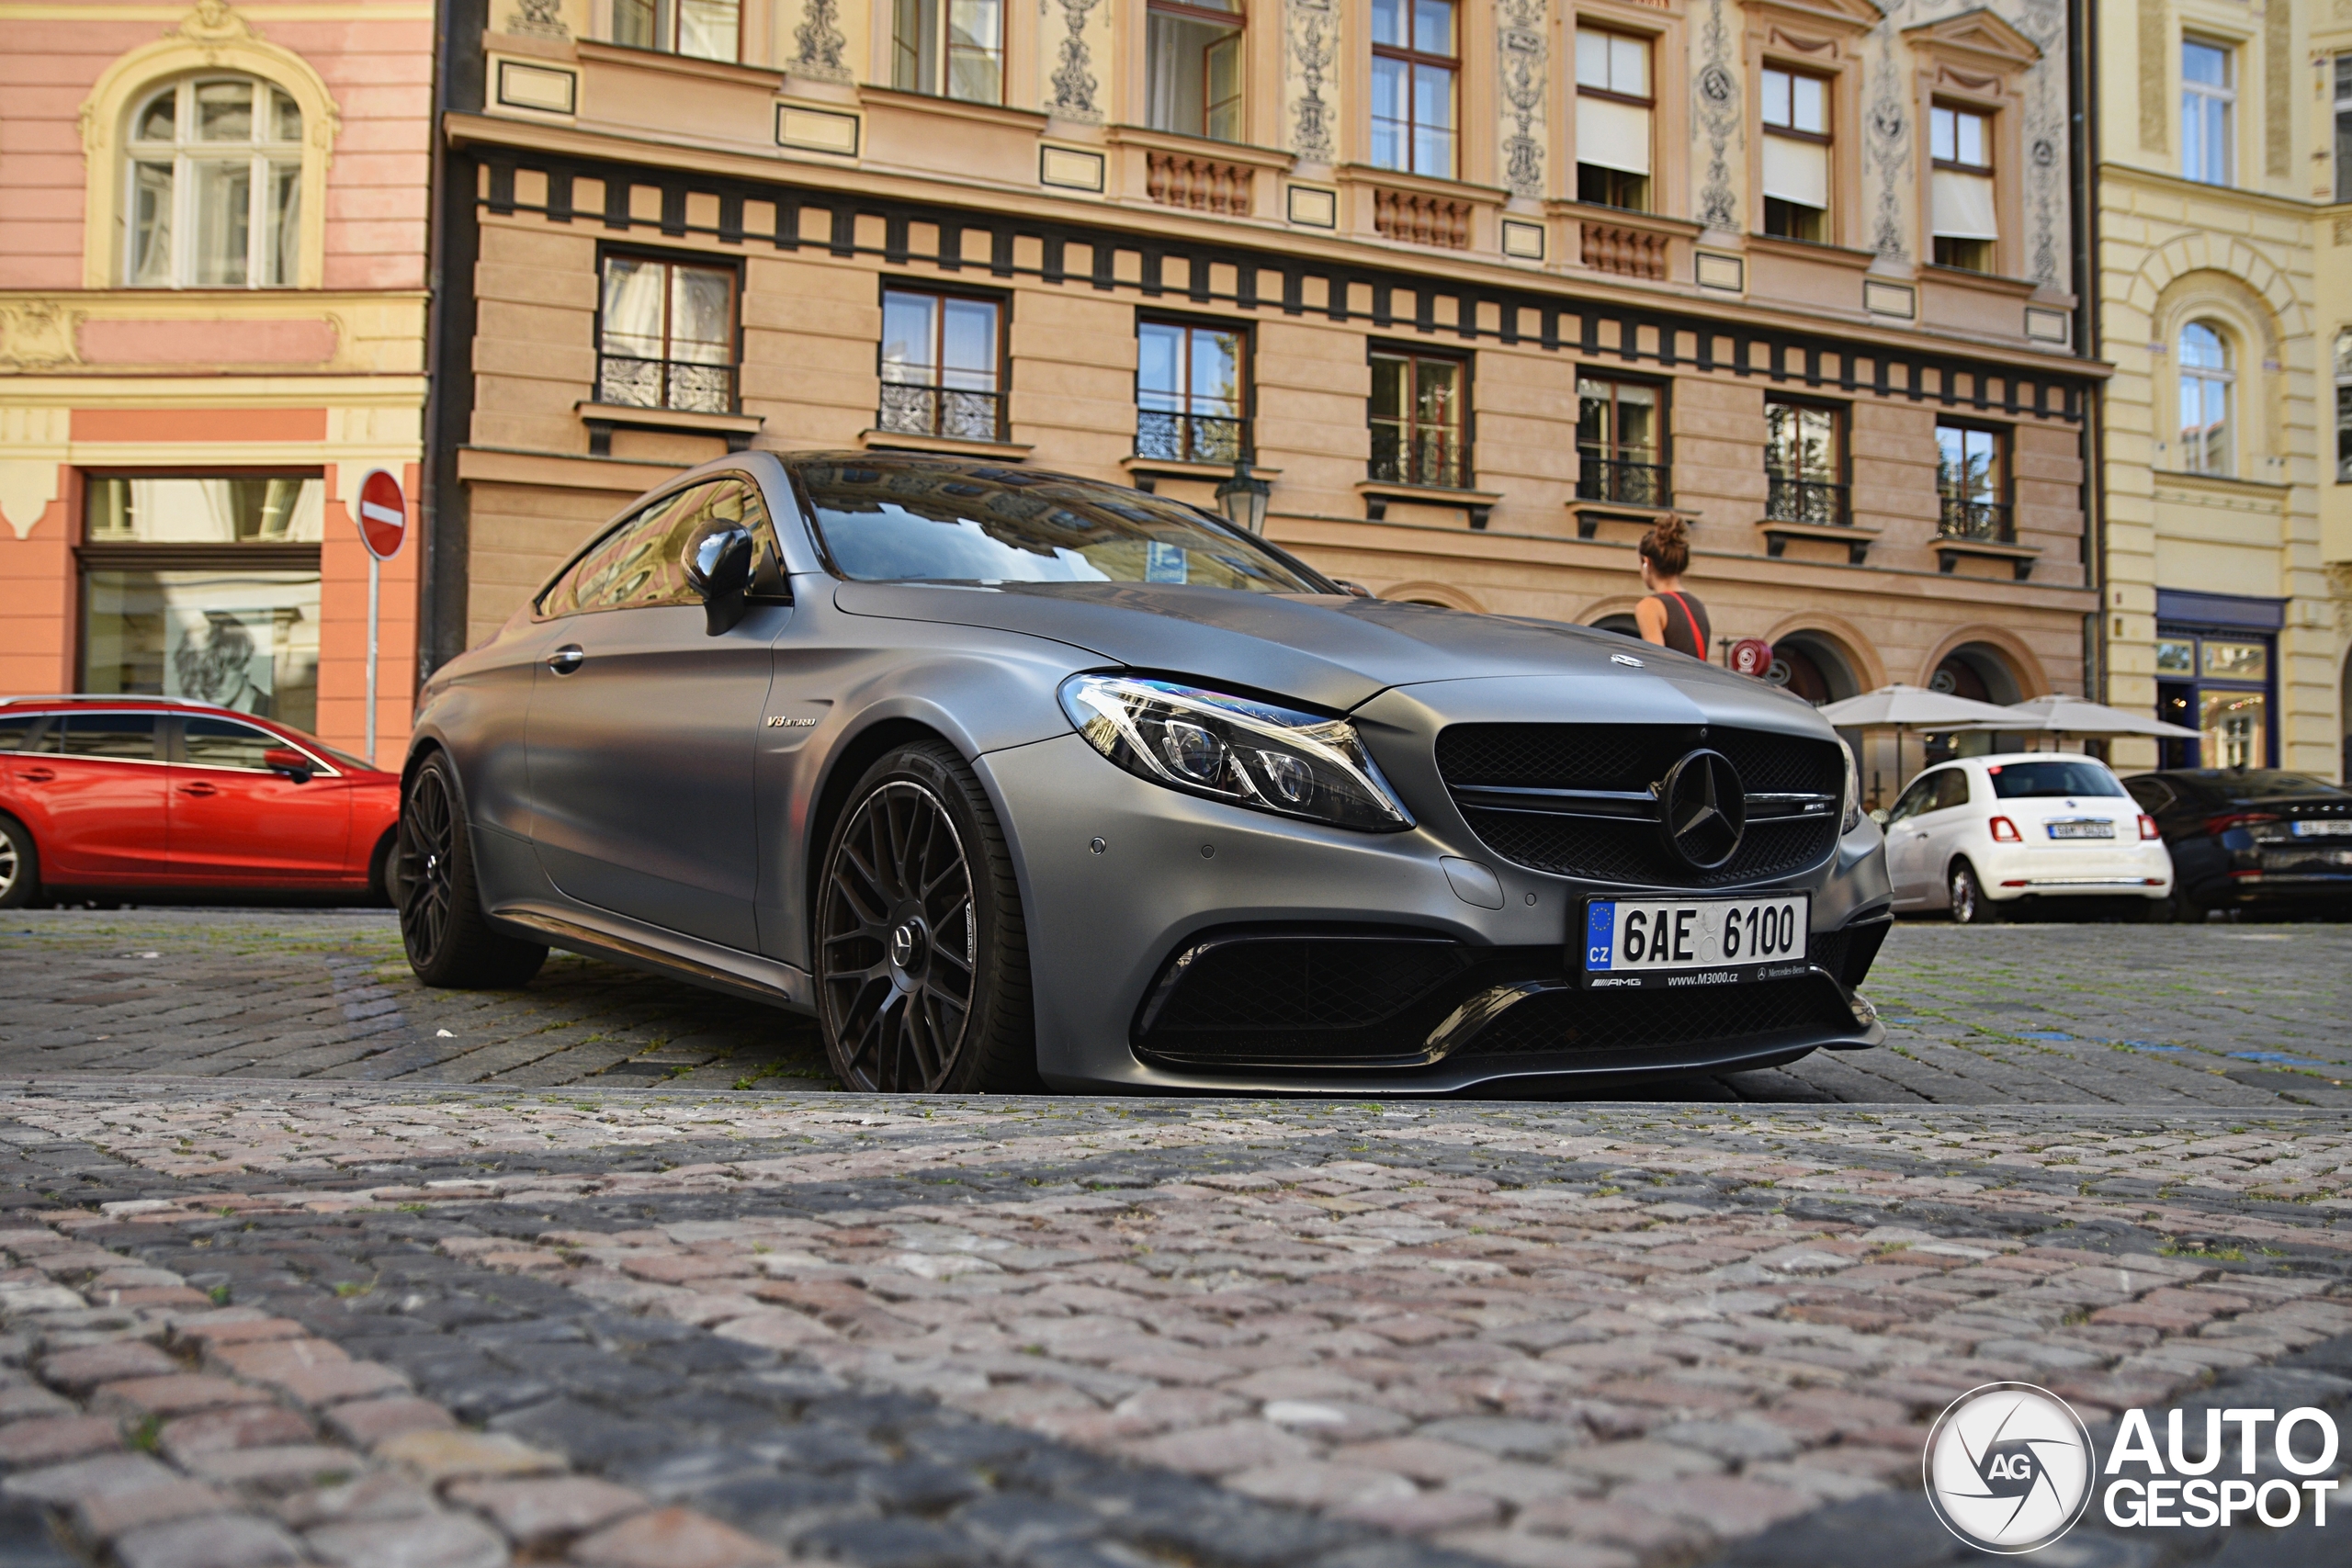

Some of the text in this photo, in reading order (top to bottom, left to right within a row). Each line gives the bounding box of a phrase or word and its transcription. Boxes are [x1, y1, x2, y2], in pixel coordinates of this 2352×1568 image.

[767, 716, 786, 728] V8
[1623, 905, 1794, 962] 6AE 6100
[1589, 947, 1610, 963] CZ
[1769, 965, 1805, 977] Mercedes-Benz
[1668, 972, 1738, 987] www.M3000.cz
